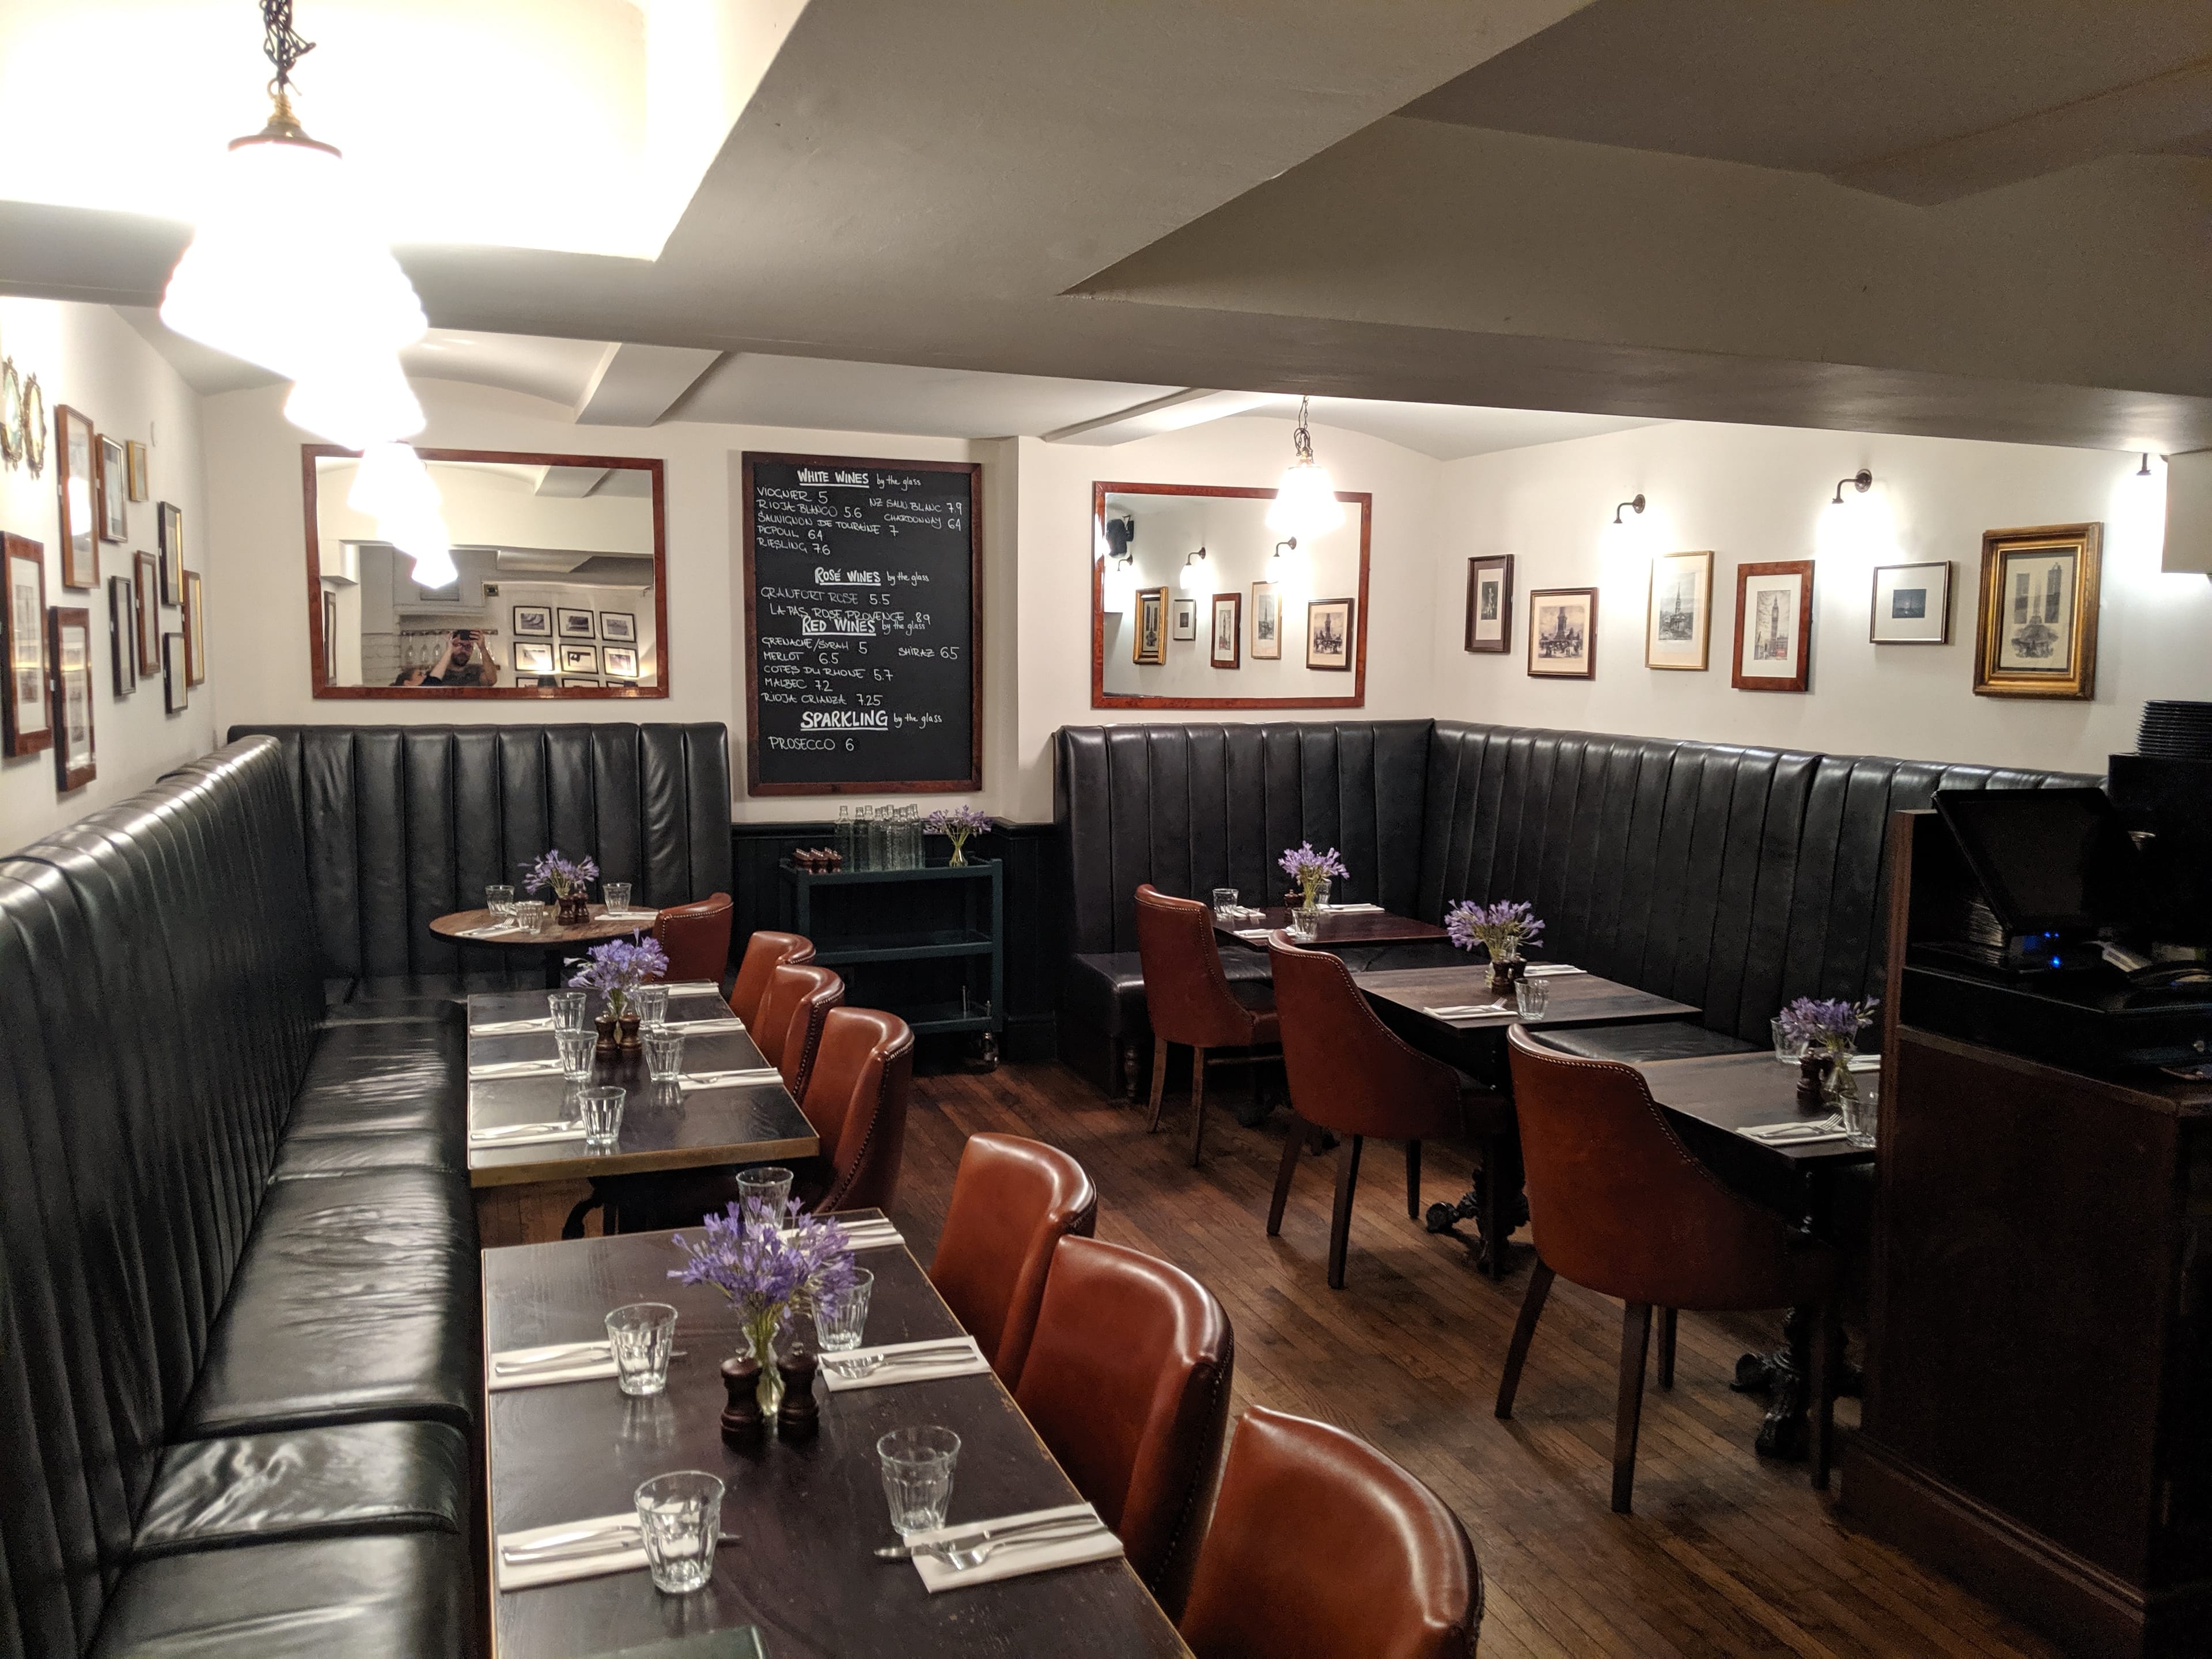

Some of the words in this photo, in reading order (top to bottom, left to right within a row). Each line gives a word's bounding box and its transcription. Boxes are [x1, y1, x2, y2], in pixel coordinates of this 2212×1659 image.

[797, 468, 830, 484] WHITE
[835, 471, 869, 484] WINES
[877, 476, 885, 489] by
[886, 476, 900, 486] the
[902, 475, 921, 491] glass
[818, 491, 829, 504] 5
[756, 499, 796, 512] RIOJA
[797, 503, 838, 517] BLANCO
[843, 506, 862, 518] 5.6
[869, 498, 883, 507] NZ
[910, 502, 942, 512] BLANC
[946, 502, 963, 515] 7.9
[757, 510, 813, 527] SAUVIGNON
[835, 521, 881, 535] TOURAINE
[889, 525, 899, 537] 7
[884, 513, 941, 529] CHARDONNAY
[757, 525, 799, 538] PICPOUL
[756, 537, 808, 554] RIESLING
[847, 571, 881, 583] WINES
[887, 572, 896, 587] by
[896, 571, 910, 582] the
[909, 573, 930, 588] glass
[869, 594, 891, 605] 5.5
[812, 607, 842, 621] ROSE
[845, 610, 904, 622] PROVENCE
[802, 616, 827, 632] RED
[834, 619, 876, 632] WINES
[882, 619, 891, 635] by
[892, 620, 904, 630] the
[905, 620, 925, 637] glass
[858, 641, 868, 654] 5
[898, 646, 935, 658] SHIRAZ
[763, 651, 804, 661] MERLOT
[819, 652, 839, 665] 6.5
[763, 665, 801, 676] COTES
[804, 666, 820, 675] DU
[823, 669, 866, 679] RHONE
[873, 669, 893, 681] 5.7
[765, 677, 808, 690] MALBEC
[761, 691, 797, 703] RIOJA
[801, 694, 847, 705] CRIANZA
[856, 694, 883, 706] 7.25
[801, 710, 888, 728] SPARKLING
[894, 713, 903, 728] by
[904, 713, 919, 723] the
[921, 713, 942, 729] glass
[768, 736, 835, 751] PROSECCO
[846, 737, 854, 752] 6
